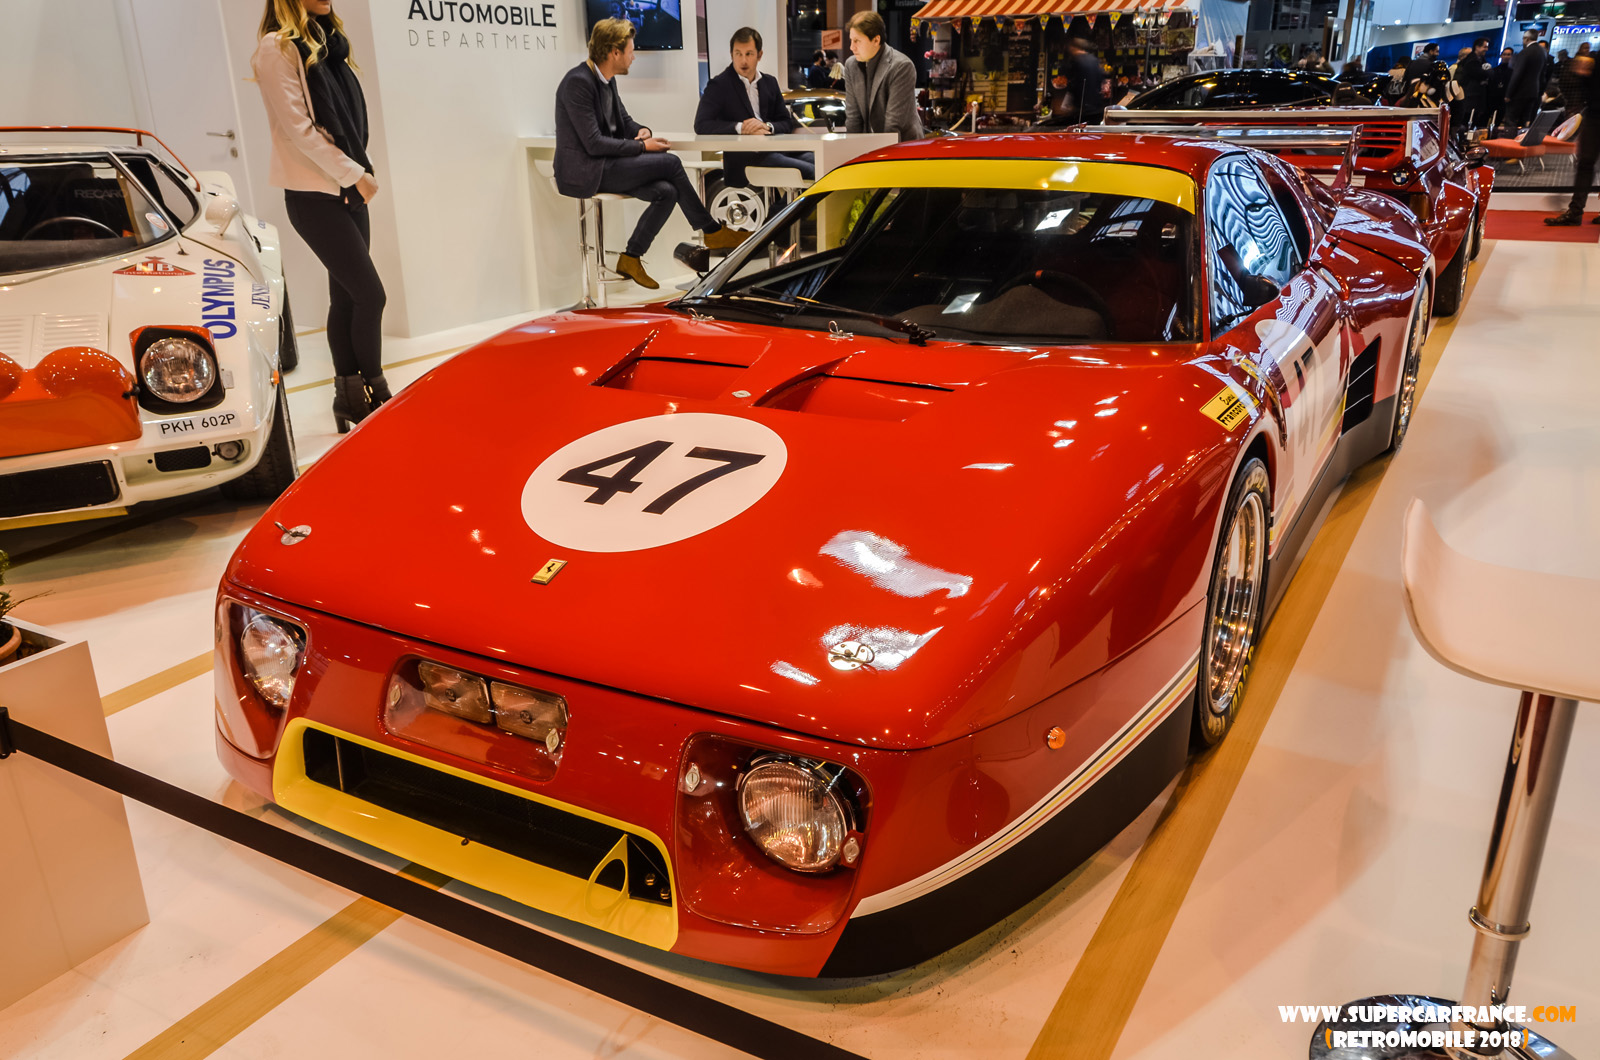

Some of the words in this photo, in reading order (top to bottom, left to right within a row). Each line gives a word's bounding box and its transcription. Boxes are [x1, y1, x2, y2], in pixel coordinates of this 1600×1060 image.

[408, 29, 558, 50] DEPARTMENT
[202, 258, 237, 340] OLYMPUS
[160, 420, 195, 435] PKH
[201, 413, 235, 428] 602P
[557, 440, 766, 515] 47
